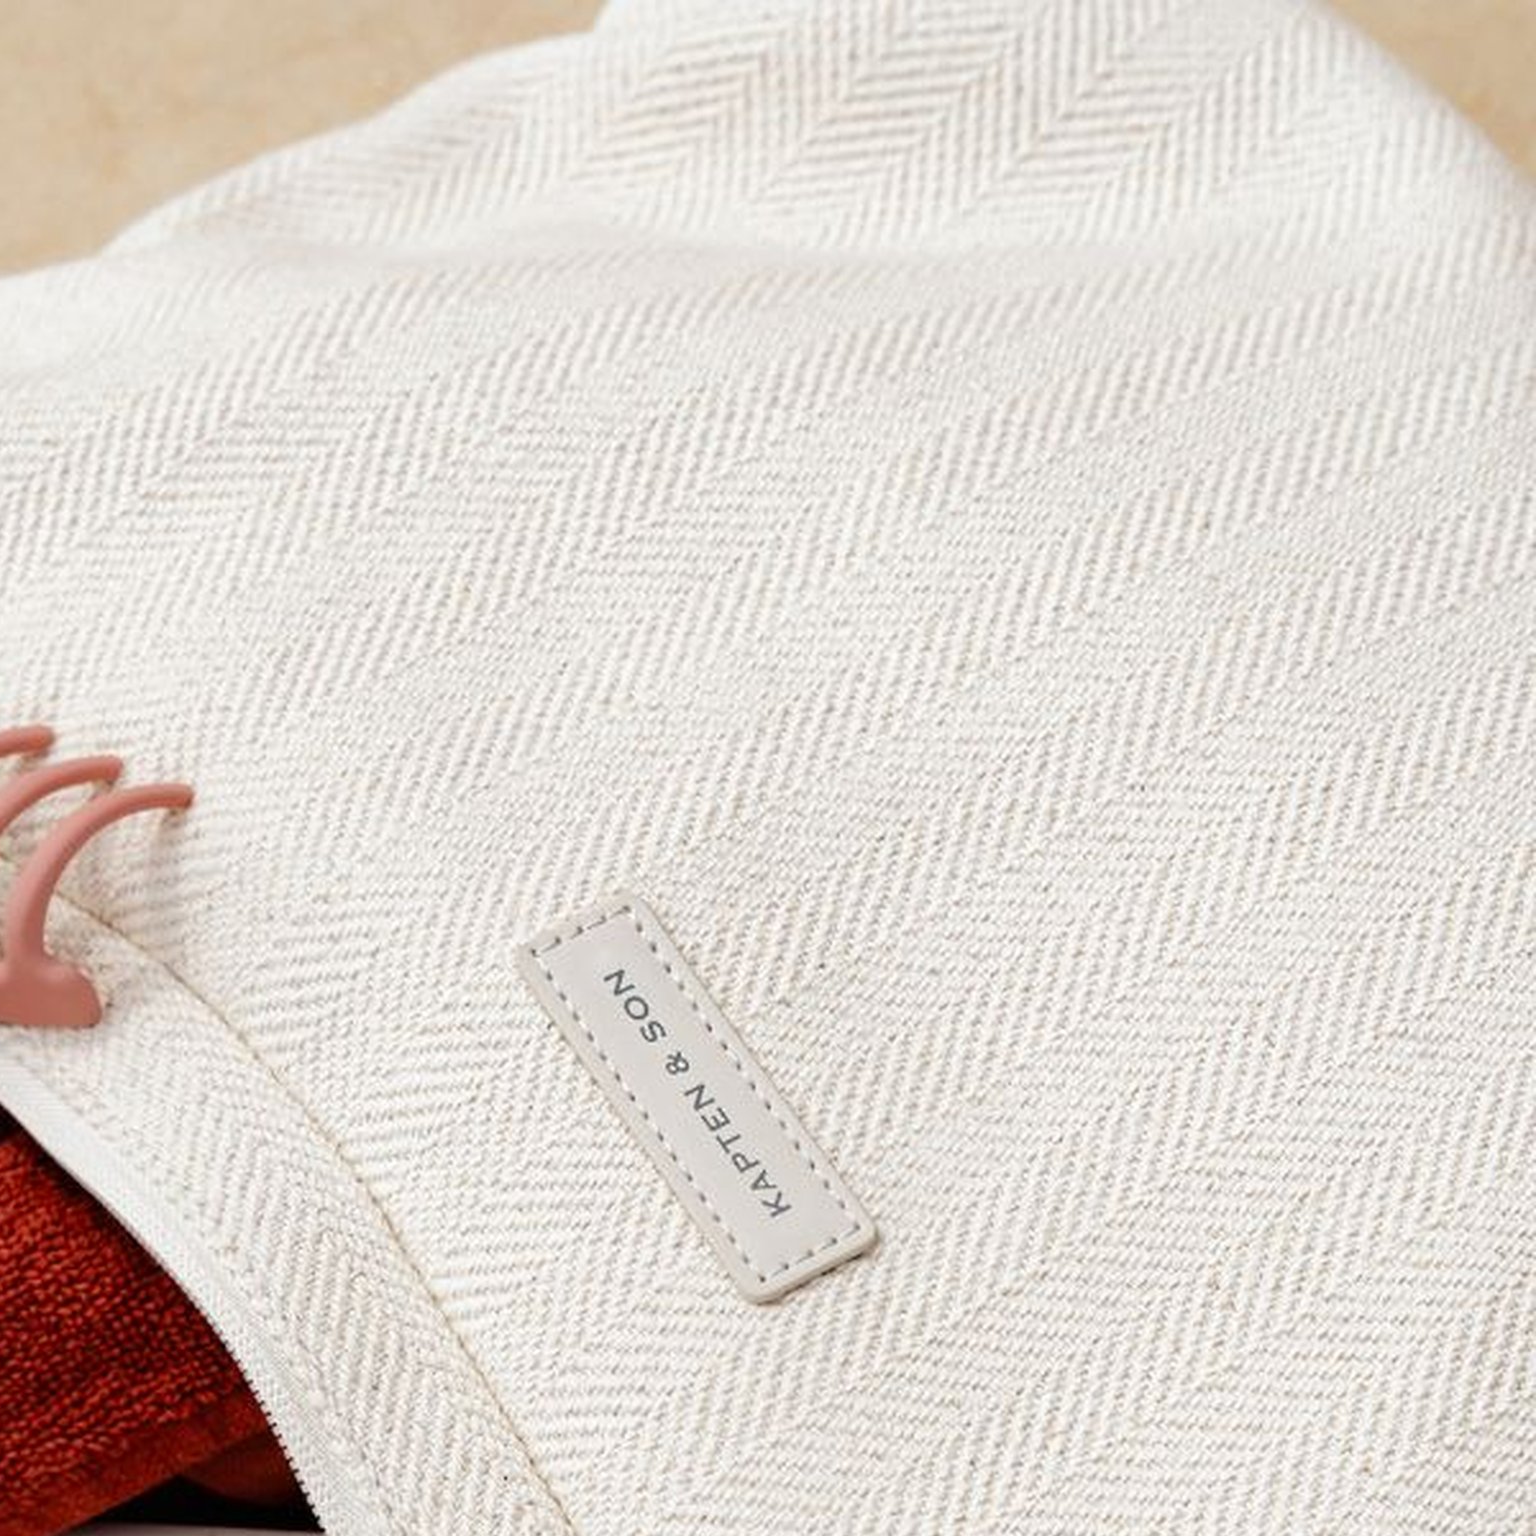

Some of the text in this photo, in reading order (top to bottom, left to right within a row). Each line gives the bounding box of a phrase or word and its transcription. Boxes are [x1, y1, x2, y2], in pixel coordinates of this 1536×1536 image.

[603, 969, 791, 1218] KAPTEN & SON
